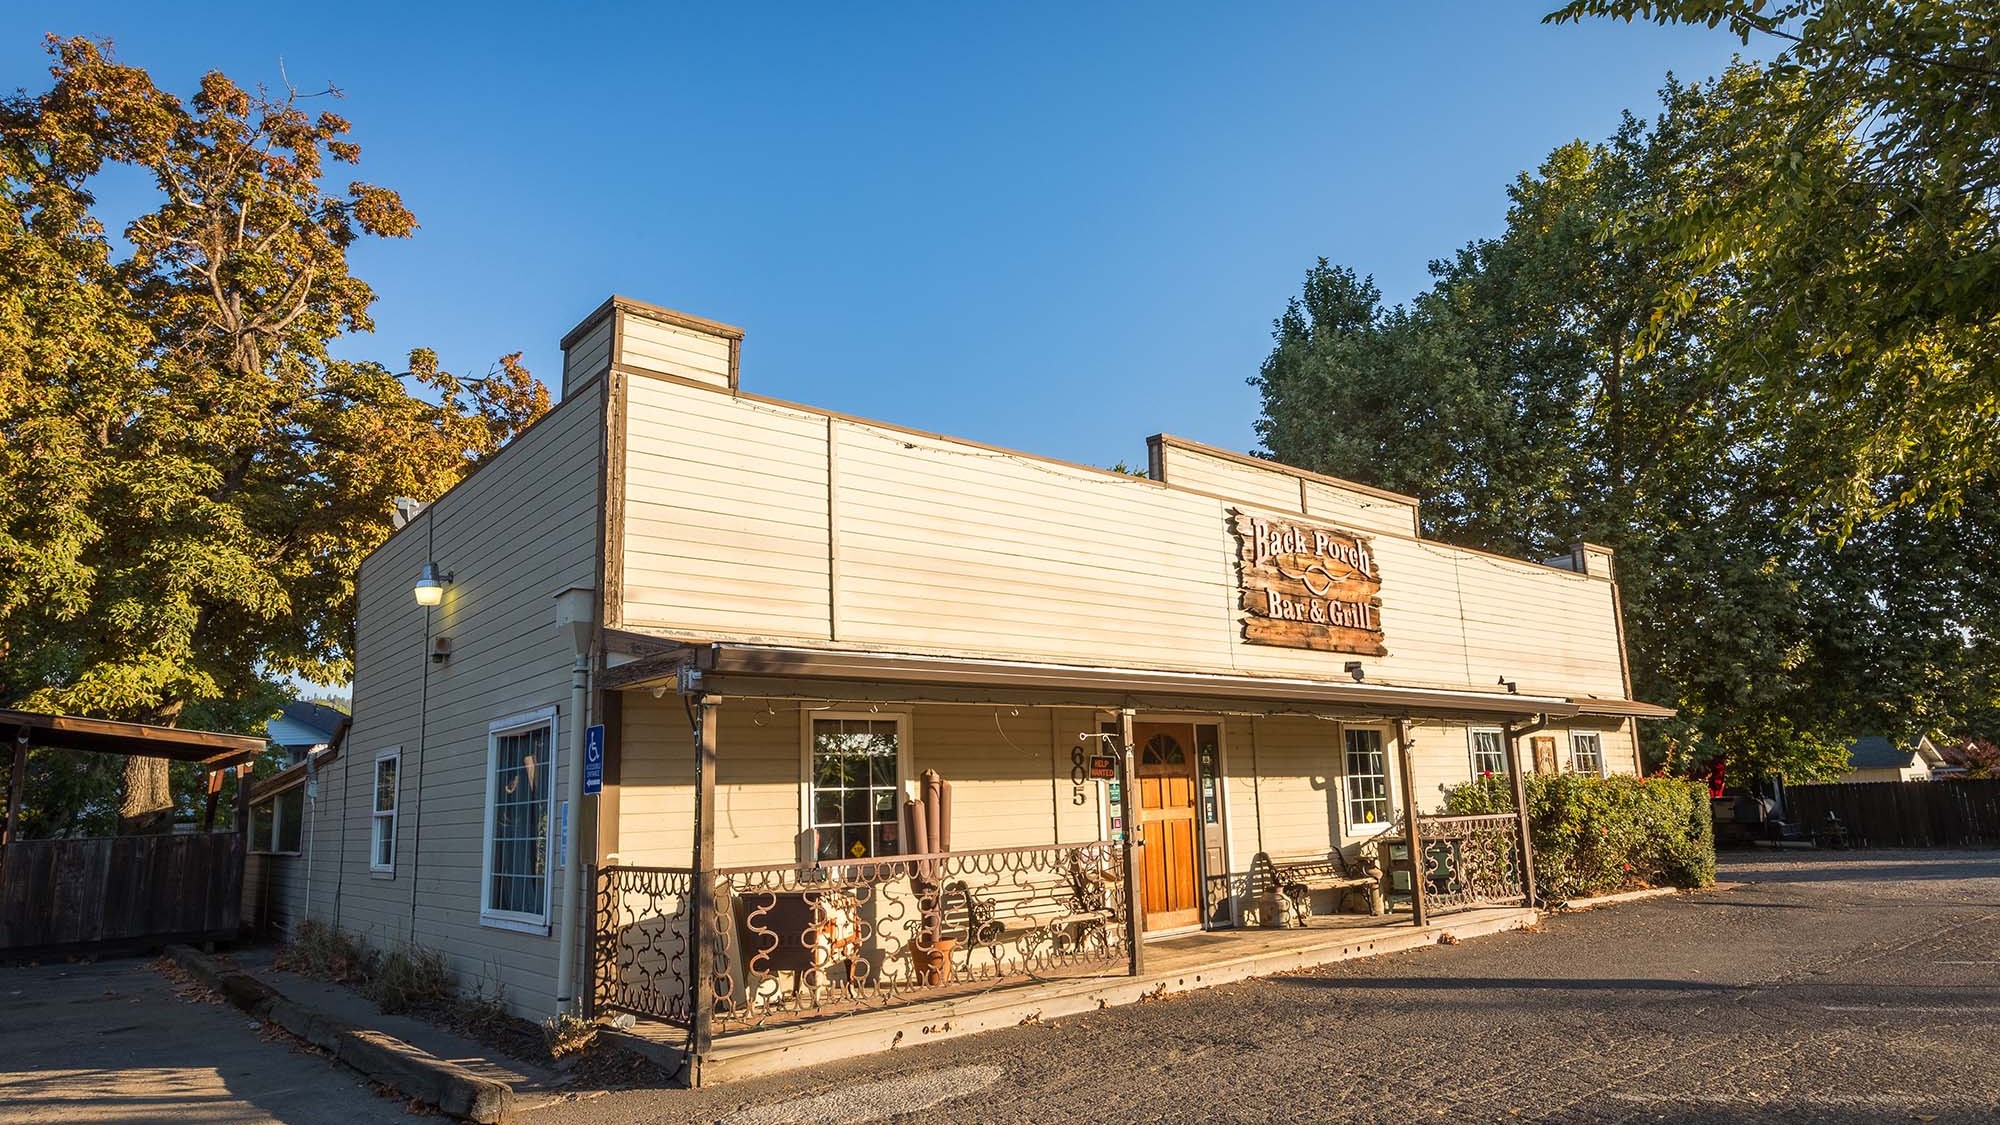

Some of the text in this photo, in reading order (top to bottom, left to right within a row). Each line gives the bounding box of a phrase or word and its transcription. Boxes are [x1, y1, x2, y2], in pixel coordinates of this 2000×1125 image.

[1252, 518, 1372, 579] Back Porch
[1266, 589, 1372, 630] Bar & Grill
[1071, 746, 1086, 806] 605
